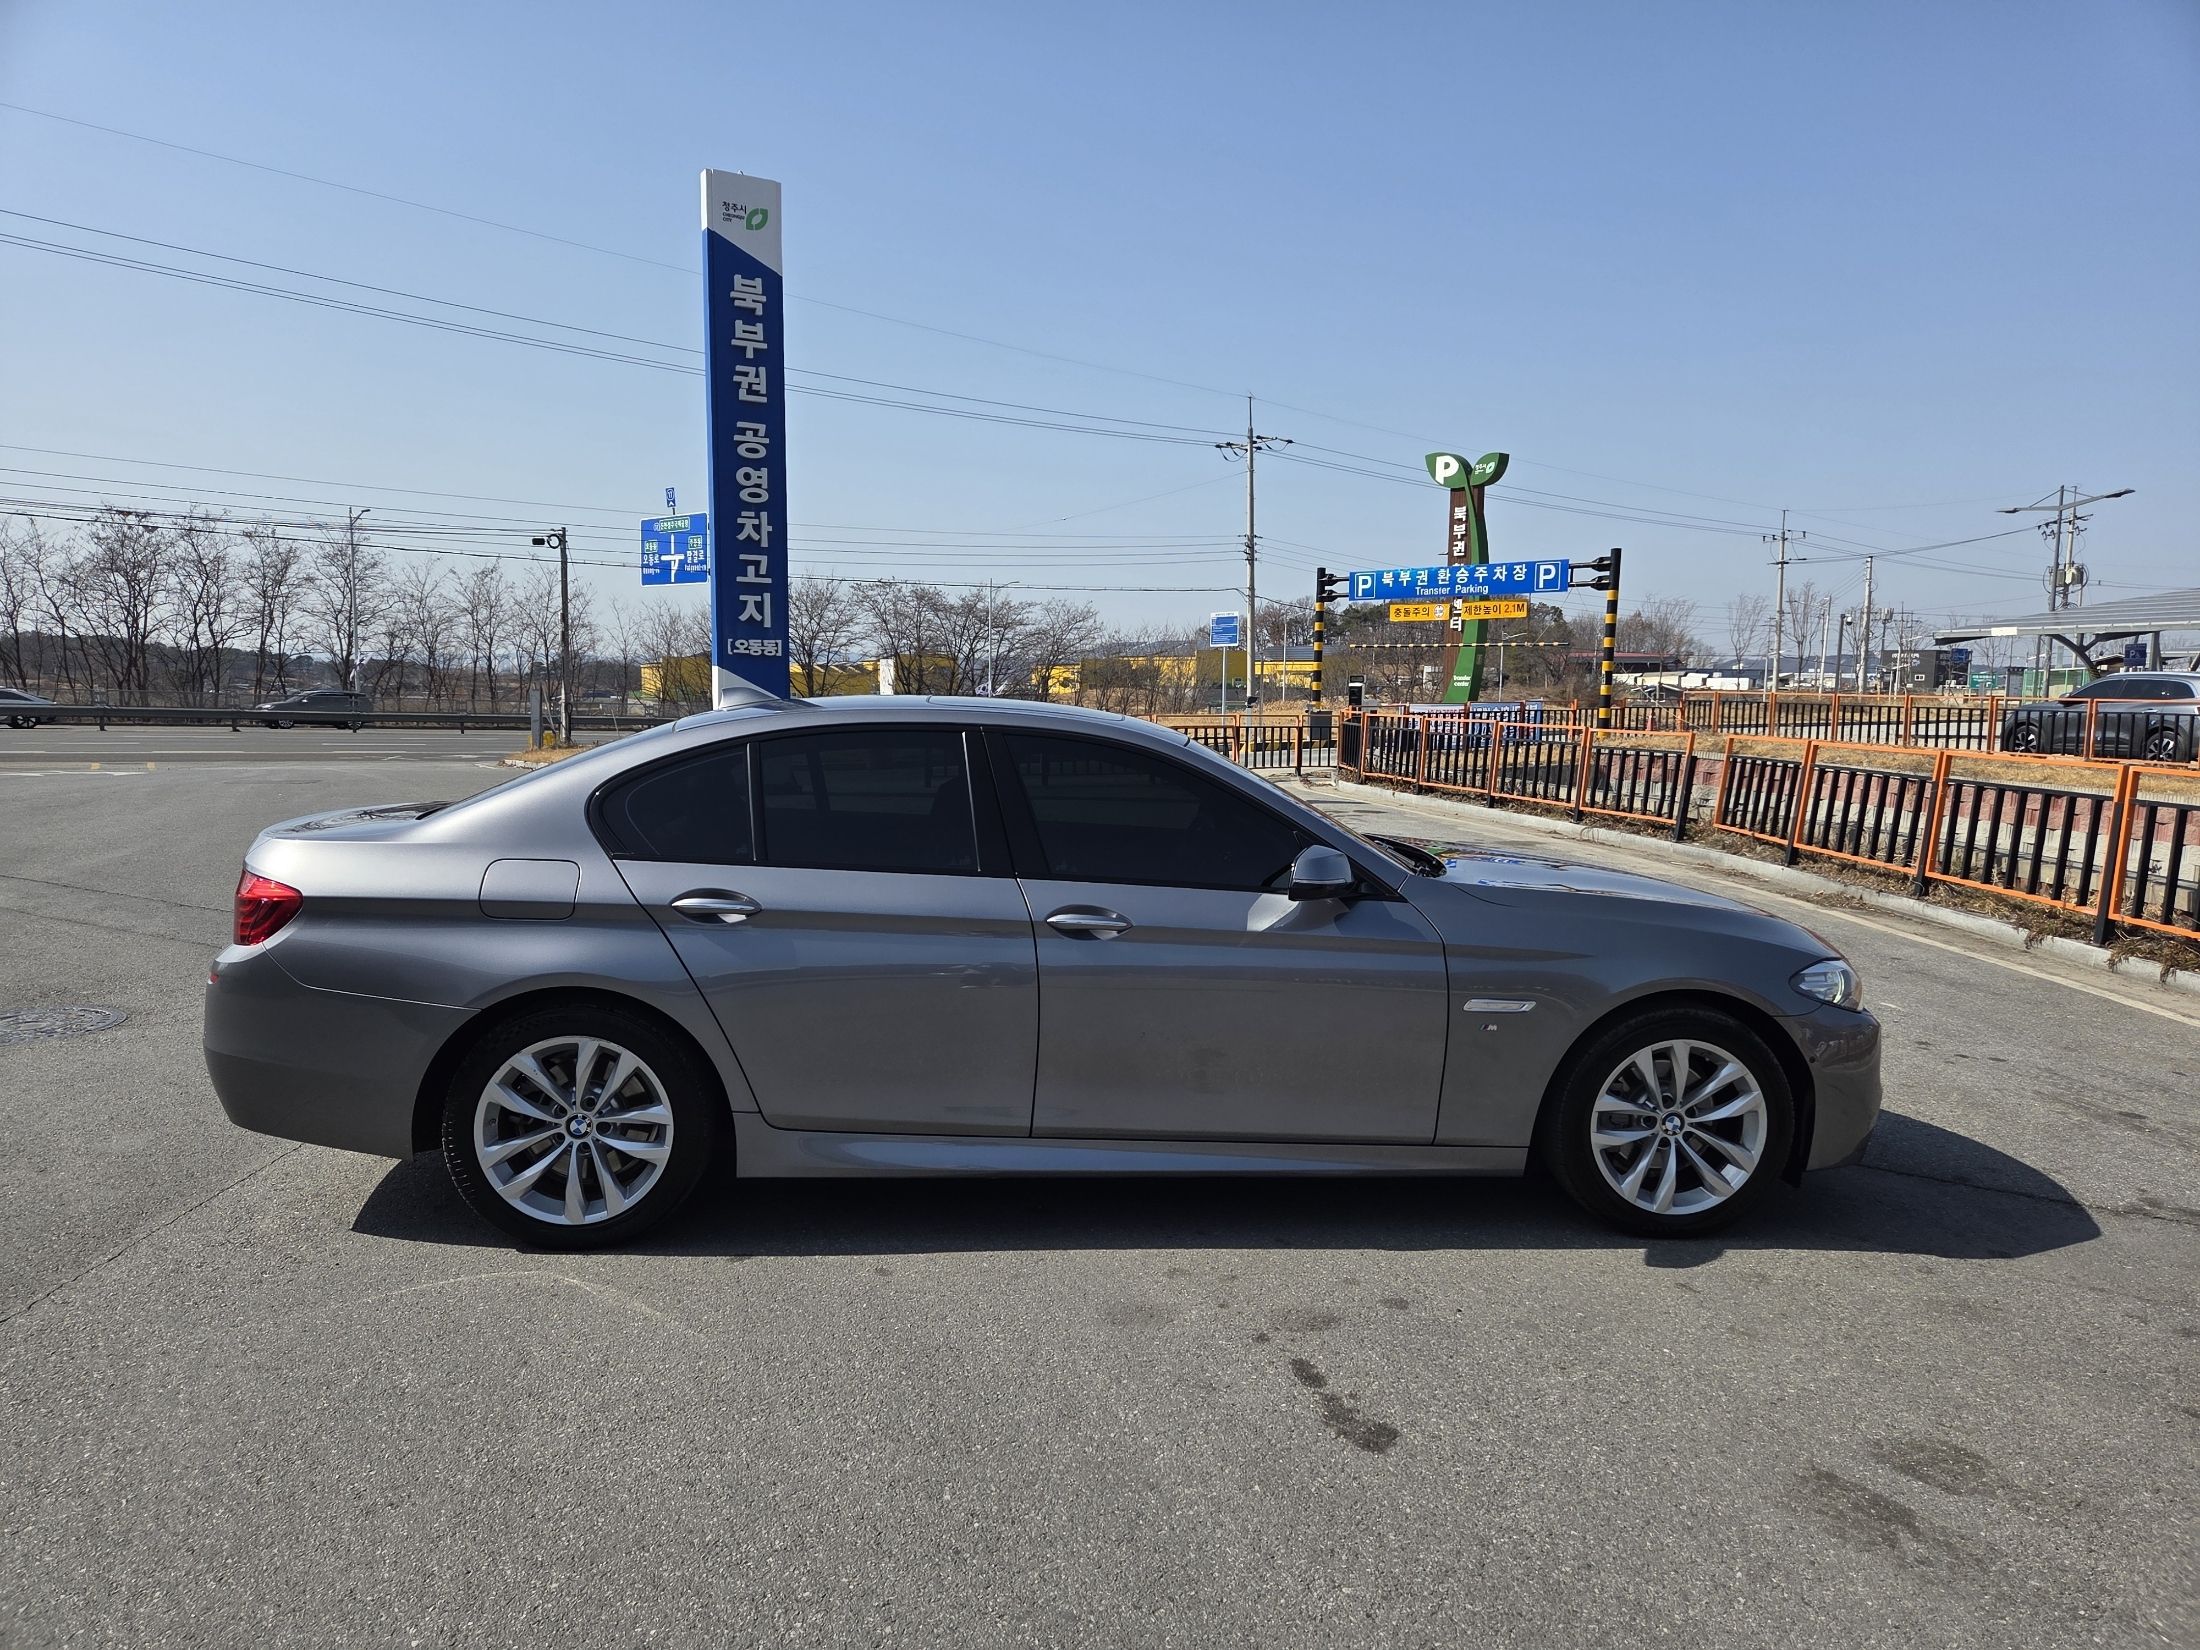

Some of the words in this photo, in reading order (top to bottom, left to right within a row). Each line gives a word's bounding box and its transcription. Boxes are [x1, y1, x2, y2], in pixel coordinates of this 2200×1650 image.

[722, 201, 747, 215] 청주시
[730, 274, 768, 404] 북부권
[1435, 455, 1460, 485] P
[733, 421, 773, 628] 공영차고지
[1452, 505, 1467, 557] 북부권
[643, 553, 660, 566] 오동로
[1357, 575, 1372, 597] P
[1381, 569, 1429, 588] 북부권
[1437, 563, 1528, 585] 환승주차장
[1538, 564, 1556, 589] P
[1415, 586, 1451, 596] Transfer
[1455, 584, 1489, 595] Parking
[1393, 606, 1430, 618] 충돌주의
[1463, 603, 1501, 616] 제한높이
[1504, 602, 1525, 614] 2.1M
